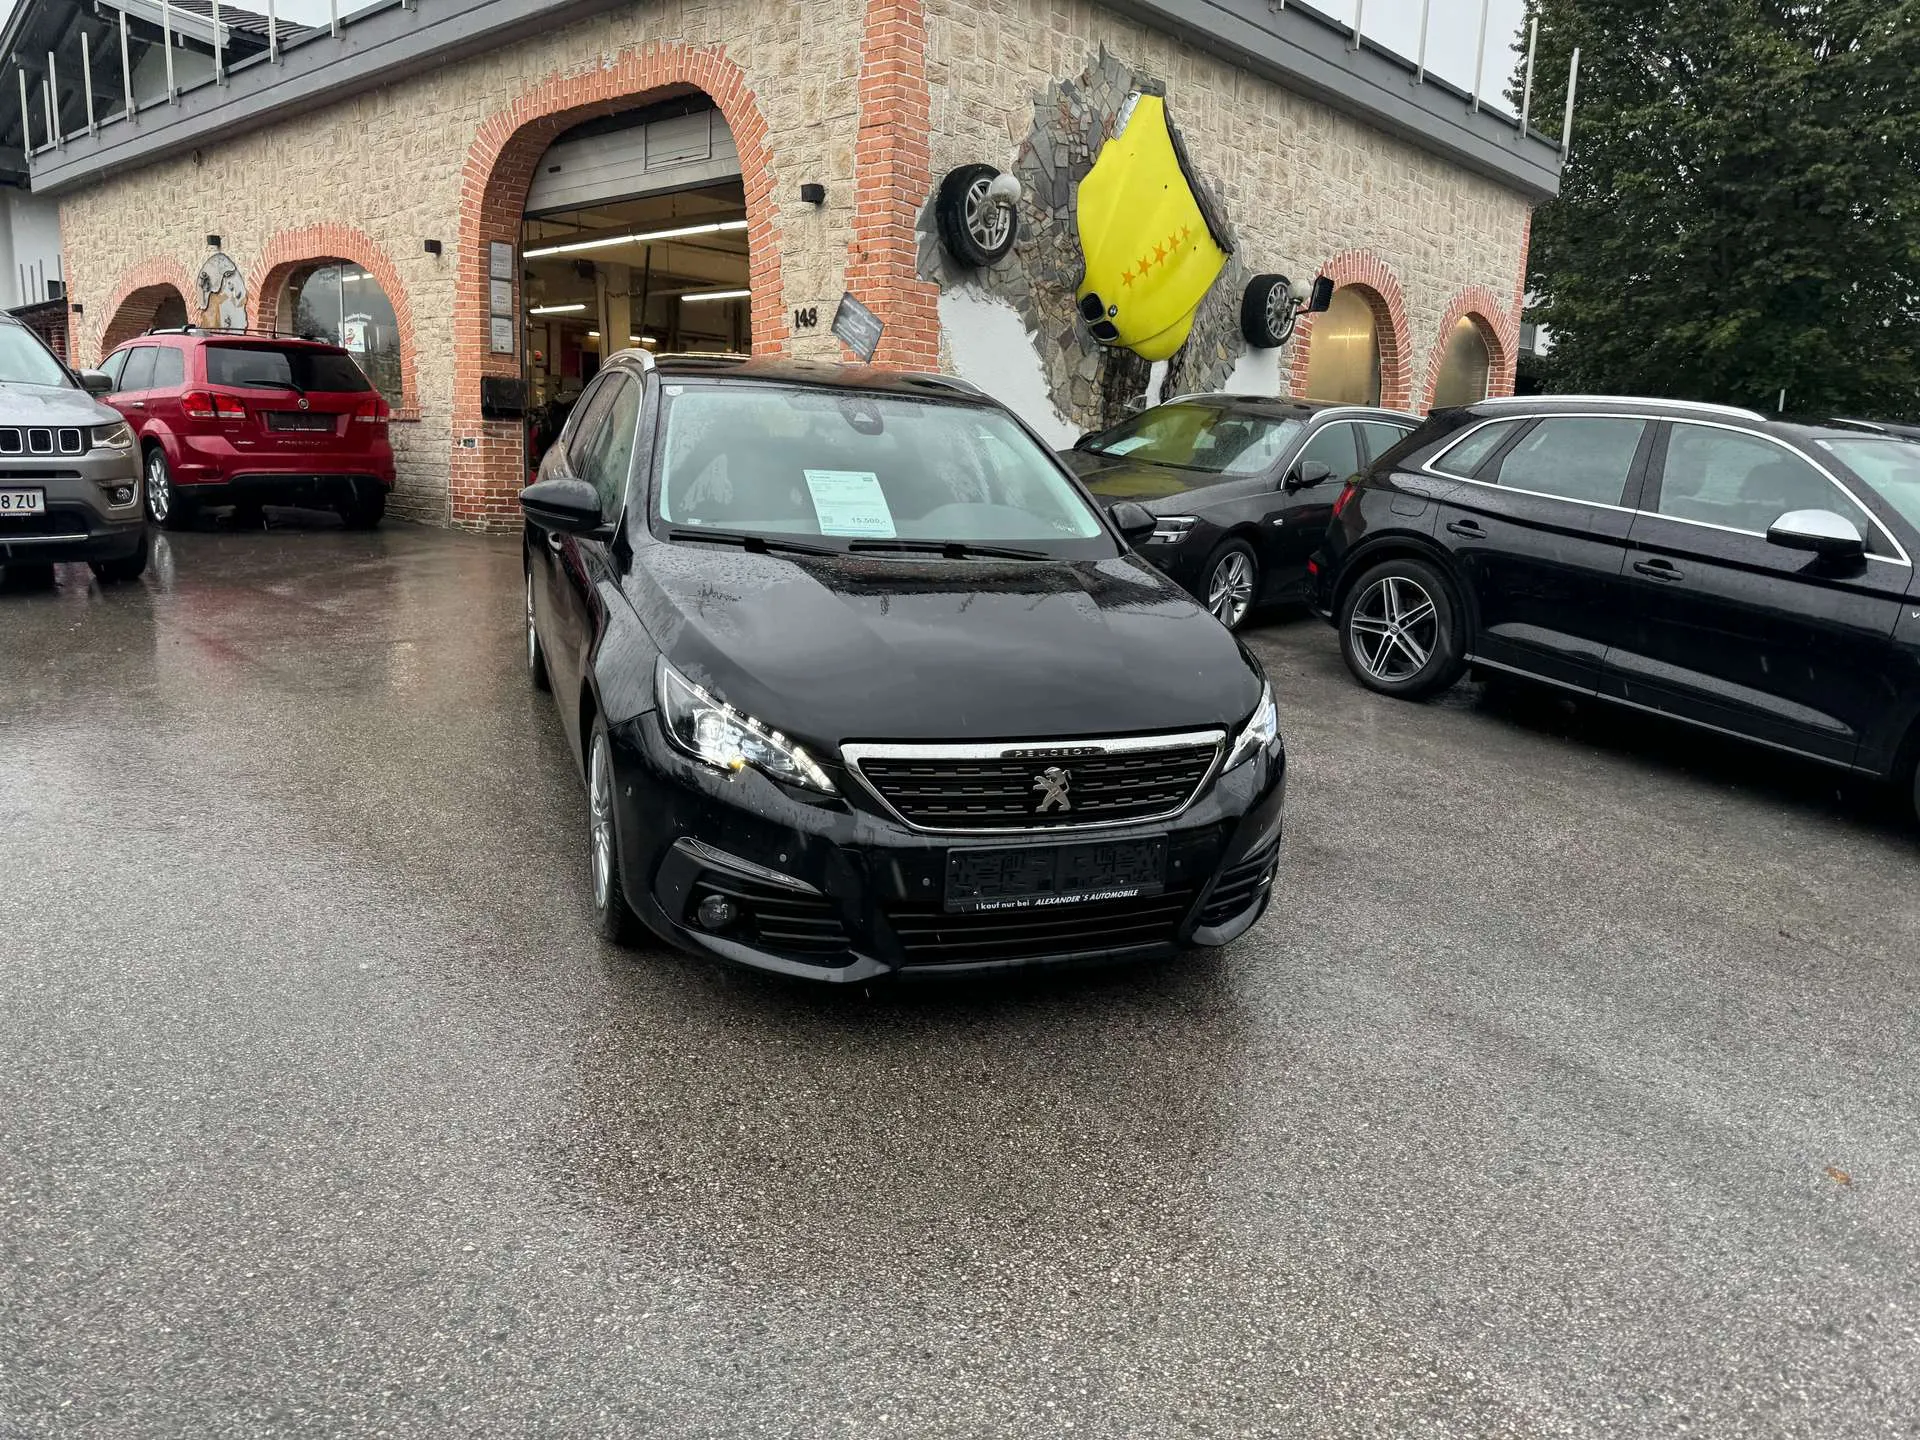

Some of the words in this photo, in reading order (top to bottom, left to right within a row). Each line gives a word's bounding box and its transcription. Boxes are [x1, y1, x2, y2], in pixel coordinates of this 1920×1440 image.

[794, 307, 818, 329] 148
[15, 494, 37, 509] ZU
[980, 901, 1000, 910] kauf
[1089, 889, 1139, 901] AUTOMOBILE
